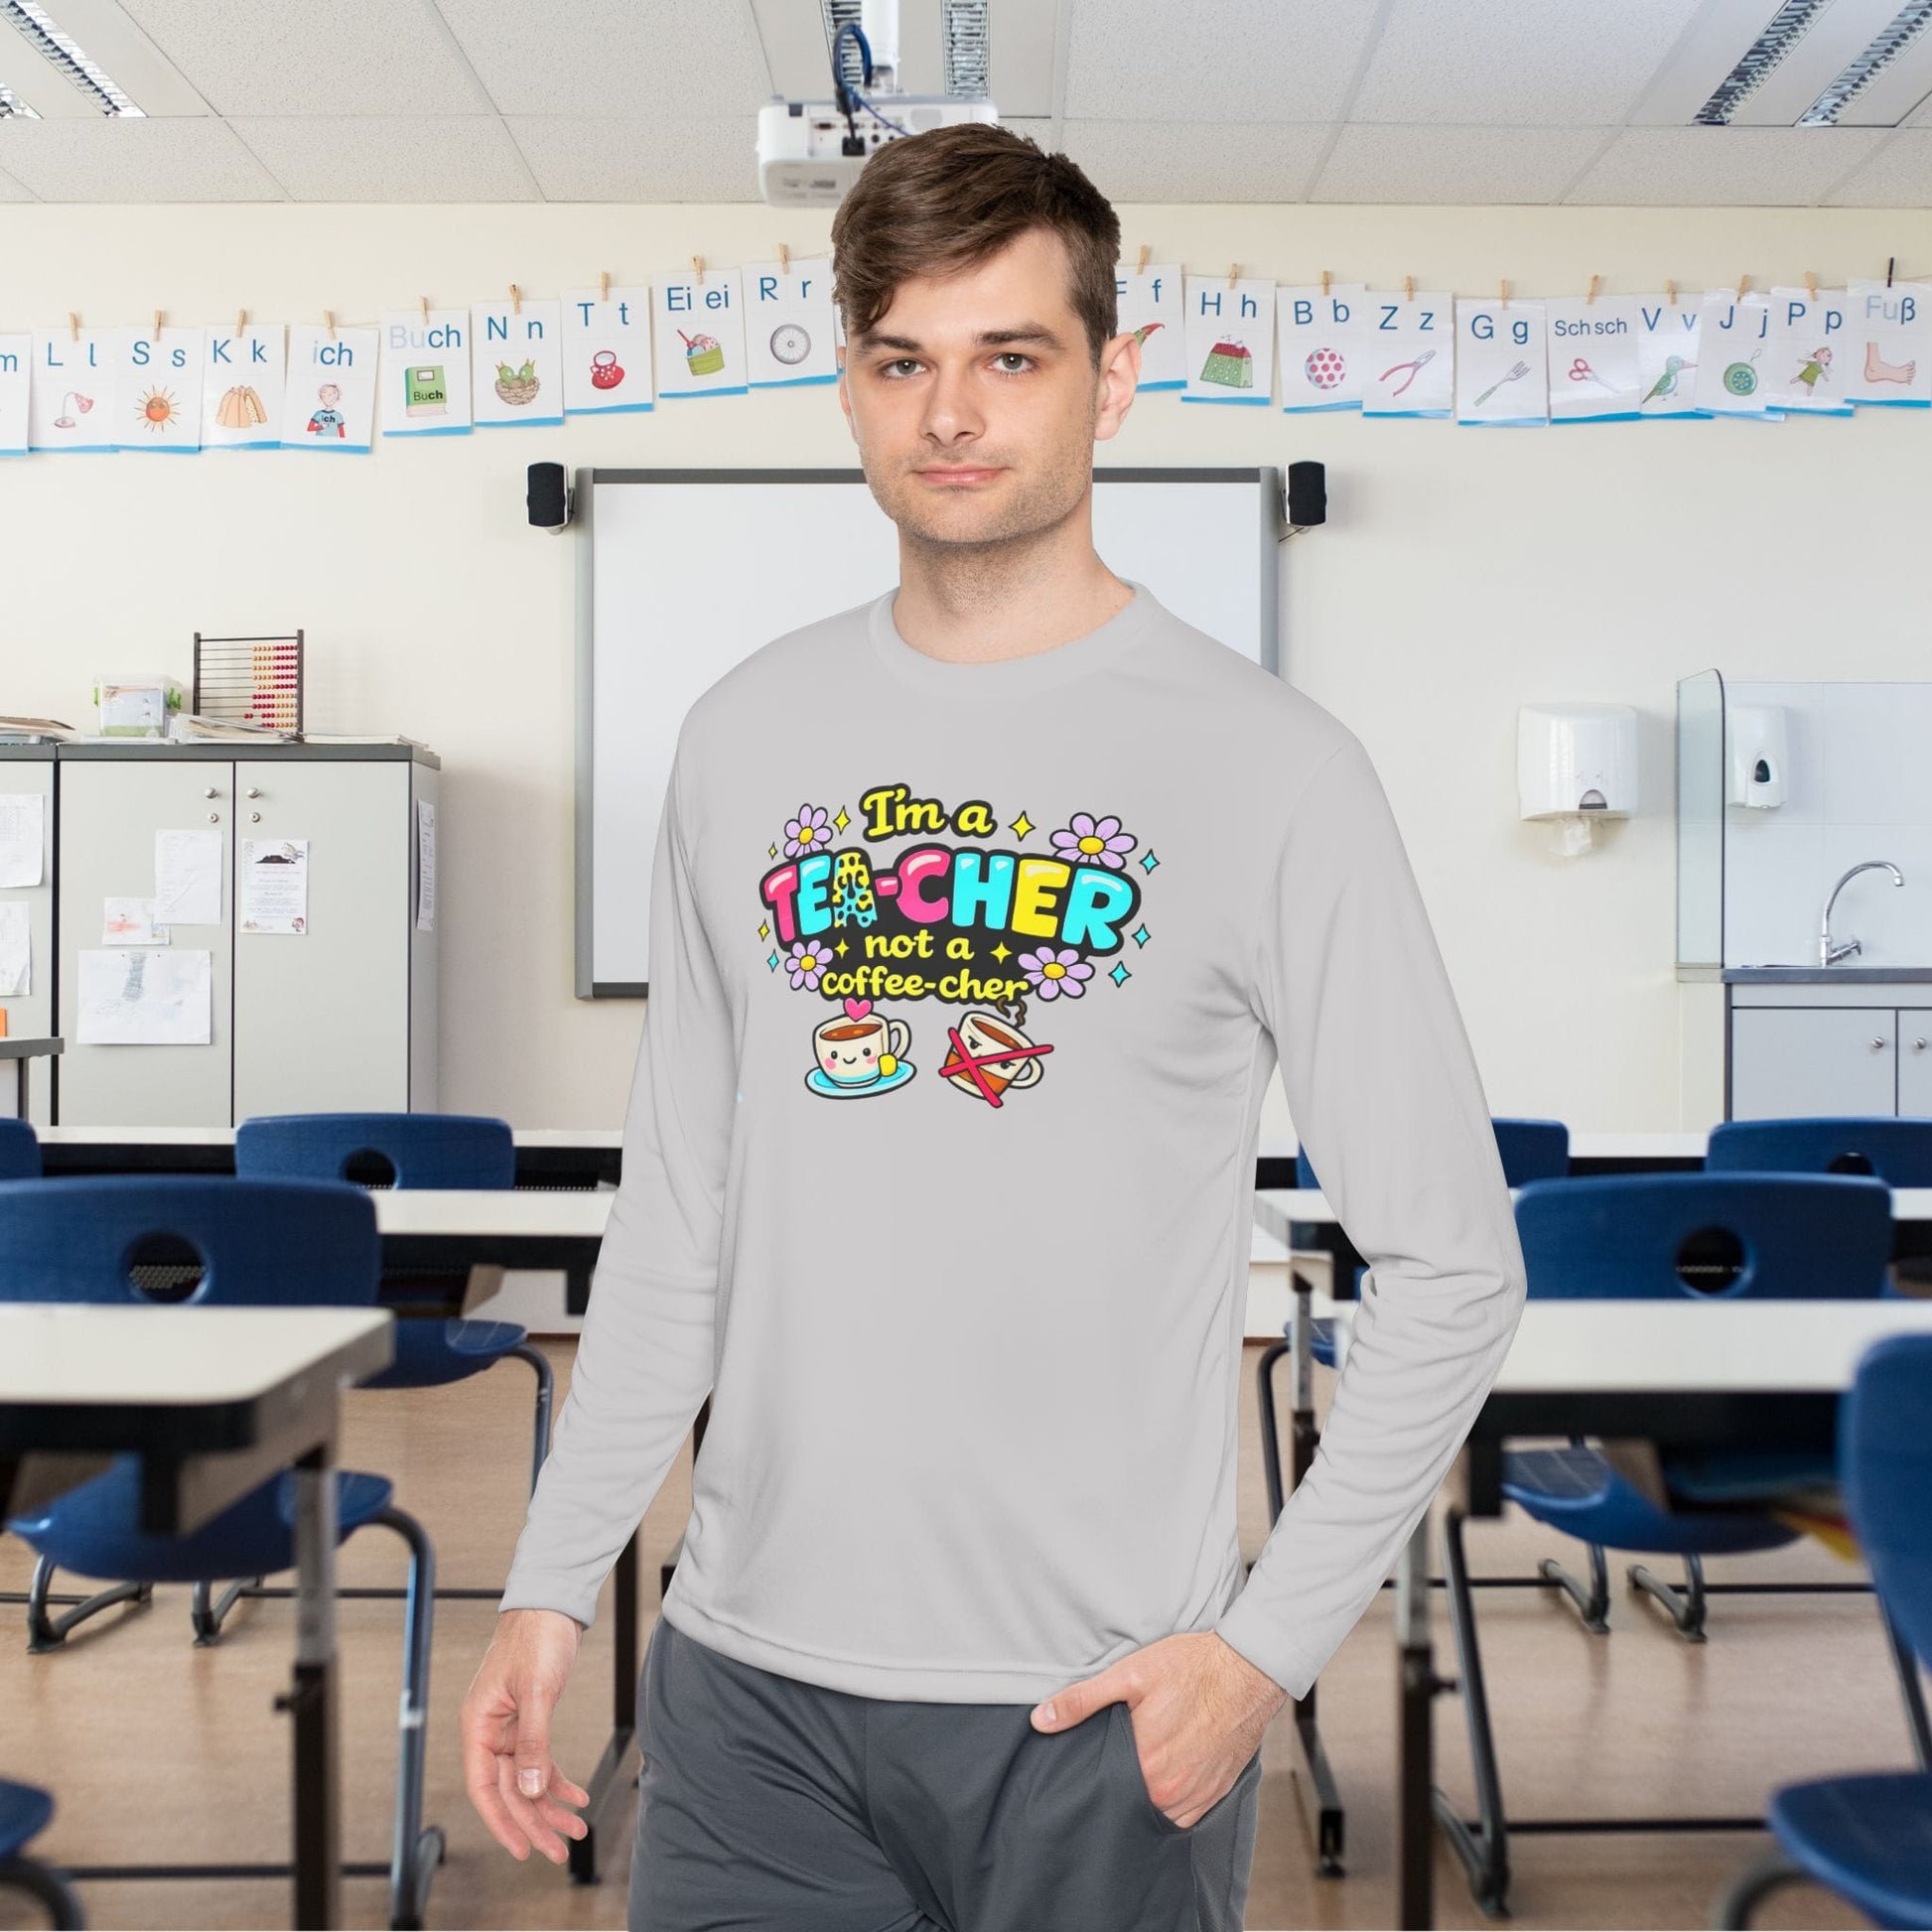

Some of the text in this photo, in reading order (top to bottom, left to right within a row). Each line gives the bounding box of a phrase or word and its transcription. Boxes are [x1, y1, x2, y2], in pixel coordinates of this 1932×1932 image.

[667, 285, 729, 311] Ei ei
[759, 277, 811, 301] R r
[1152, 279, 1162, 303] f
[577, 303, 629, 327] T t
[1201, 292, 1256, 318] H h
[1295, 299, 1350, 325] B b
[1866, 296, 1916, 325] Fuß
[487, 317, 543, 341] N n
[1379, 306, 1434, 331] Z z
[1471, 315, 1528, 345] G g
[1555, 318, 1627, 337] Sch sch
[1641, 308, 1697, 331] V v
[1720, 306, 1767, 339] J j
[1788, 302, 1843, 335] P p
[390, 325, 461, 348] Buch
[48, 343, 64, 366] L
[132, 342, 186, 367] S s
[213, 339, 267, 363] K k
[313, 340, 353, 366] ich
[413, 390, 444, 401] Buch
[321, 413, 336, 423] ich
[863, 787, 993, 837] I'm a
[763, 848, 1134, 950] TEA-CHER
[864, 929, 974, 960] not a
[821, 965, 1030, 1002] coffee-cher
